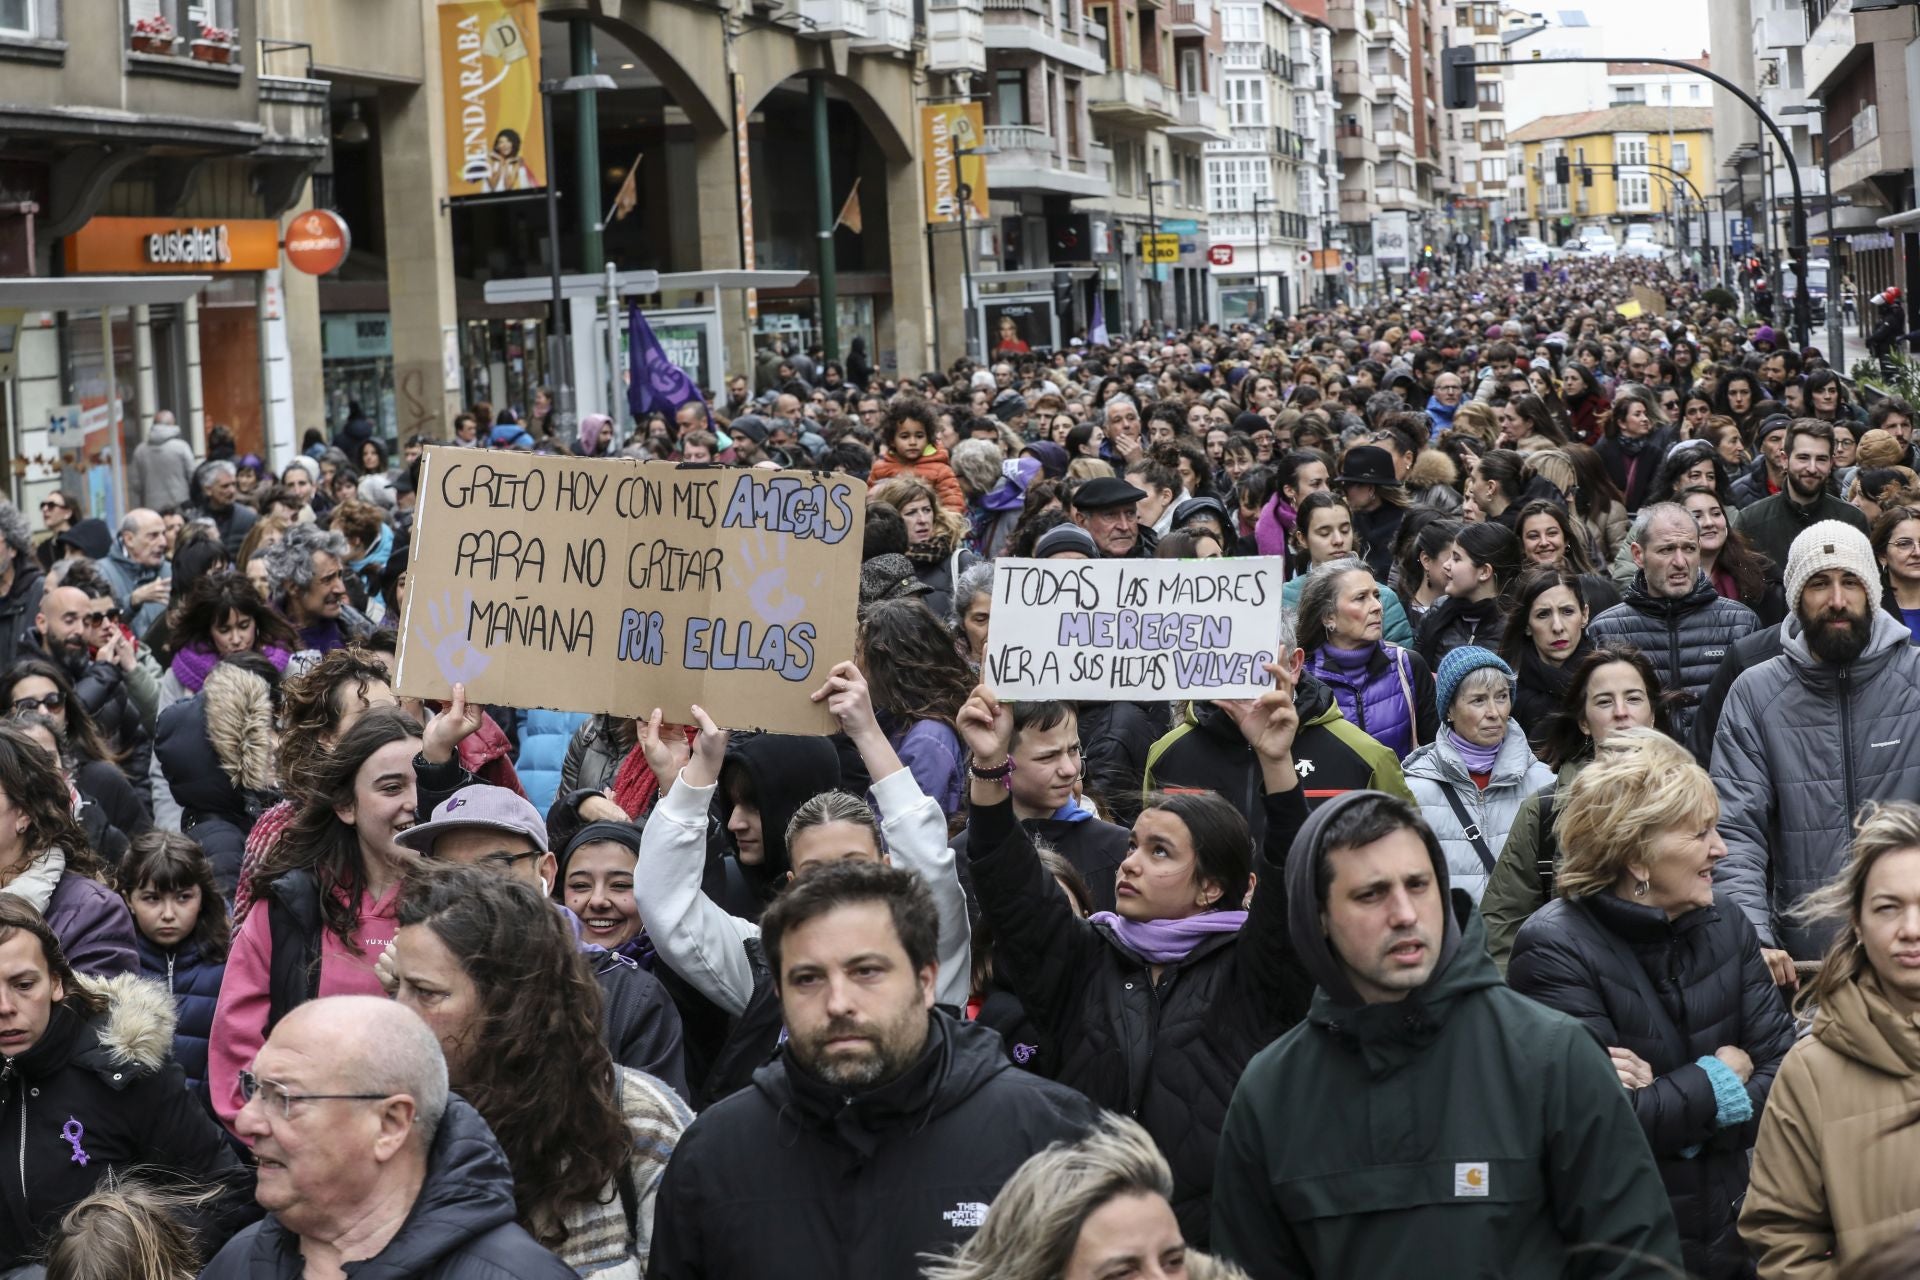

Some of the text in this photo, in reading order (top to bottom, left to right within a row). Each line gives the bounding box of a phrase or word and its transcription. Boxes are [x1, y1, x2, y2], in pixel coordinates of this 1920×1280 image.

[497, 25, 517, 48] D
[457, 14, 492, 180] DENDARABA
[932, 113, 956, 214] DENDARABA
[149, 226, 217, 263] euskaltel
[442, 464, 853, 544] GRITO HOY CON MIS AMIGAS
[454, 530, 724, 592] PARA NO GRITAR
[1000, 566, 1268, 611] TODAS LAS MADRES
[467, 596, 816, 682] MAÑANA POR ELLAS
[989, 644, 1274, 690] VER A SUS HIJAS VOLVER
[943, 1211, 977, 1220] NORTH
[952, 1219, 977, 1227] FACE
[957, 1202, 977, 1211] THE
